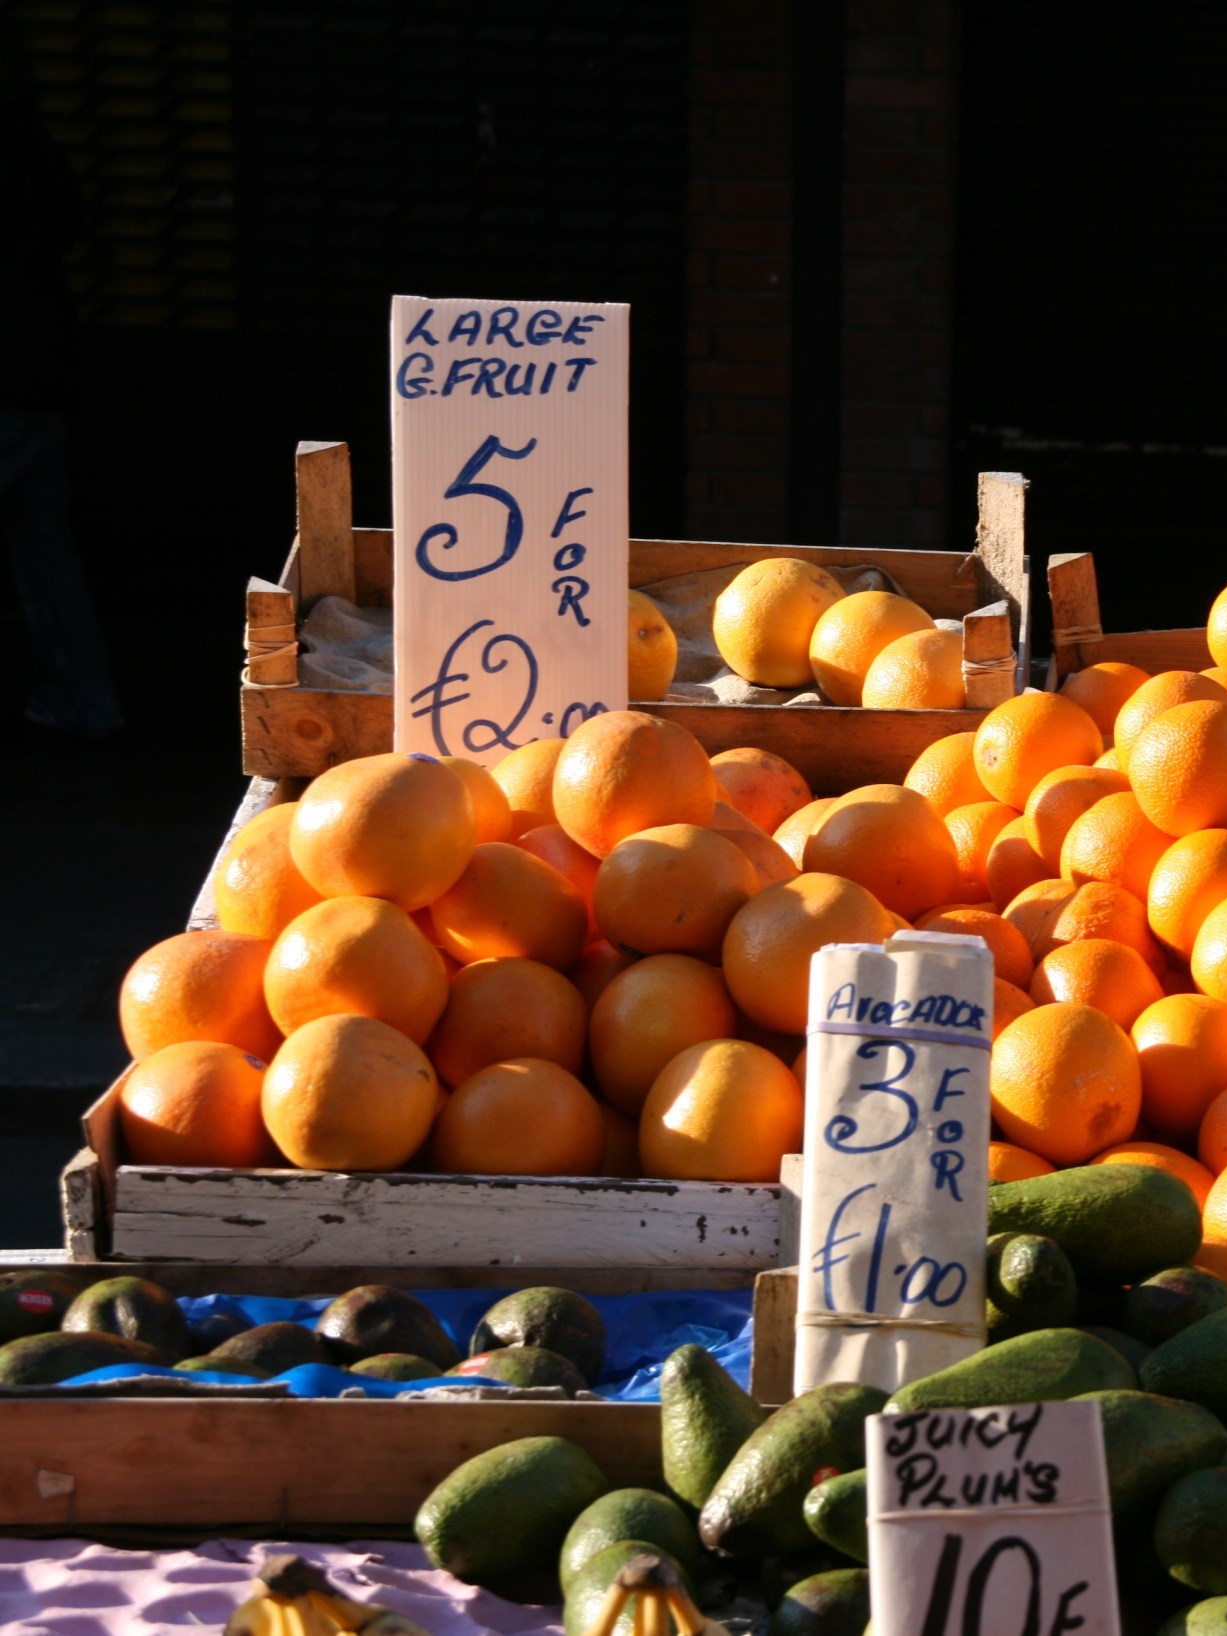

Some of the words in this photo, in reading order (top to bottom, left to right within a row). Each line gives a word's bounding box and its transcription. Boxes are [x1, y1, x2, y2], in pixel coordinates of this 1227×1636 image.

[405, 306, 605, 348] LARGE
[396, 352, 598, 399] G.FRUIT
[415, 434, 538, 582] 5
[551, 488, 594, 627] FOR
[824, 1039, 919, 1154] 3
[930, 1067, 971, 1201] FOR
[886, 1403, 1043, 1460] JUICY
[921, 1533, 1042, 1636] 10
